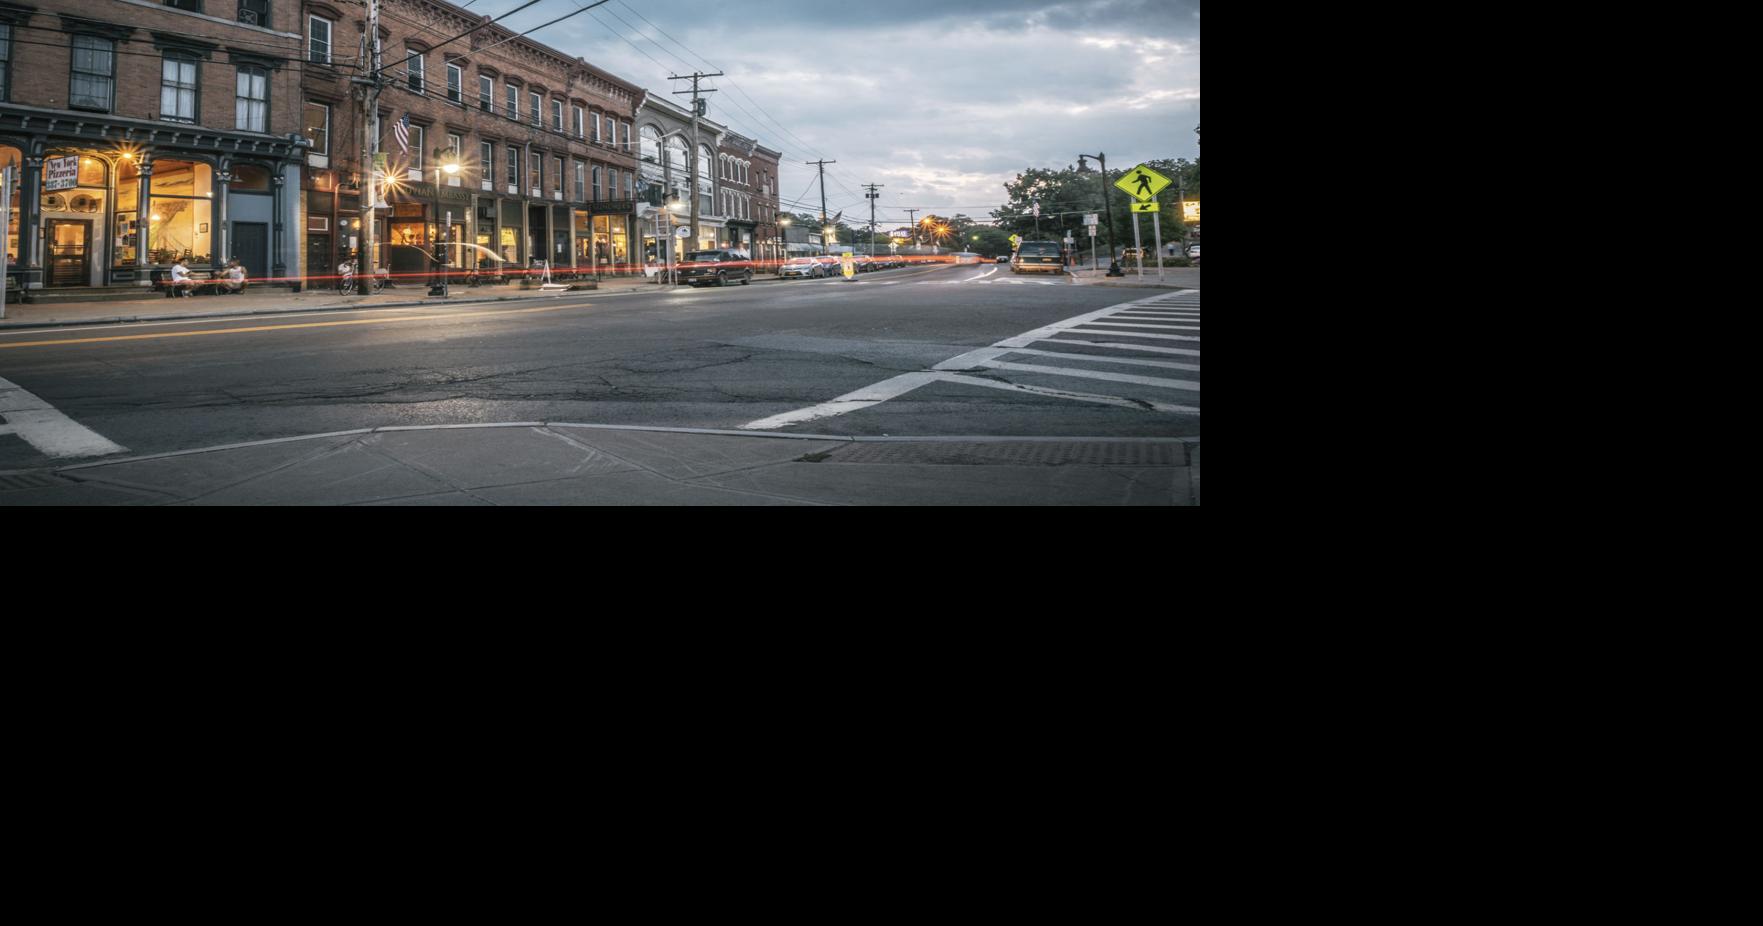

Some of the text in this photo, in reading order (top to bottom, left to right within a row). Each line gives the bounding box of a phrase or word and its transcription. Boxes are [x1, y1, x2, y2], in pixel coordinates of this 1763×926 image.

[48, 157, 77, 169] New York
[48, 168, 76, 179] Pizzeria
